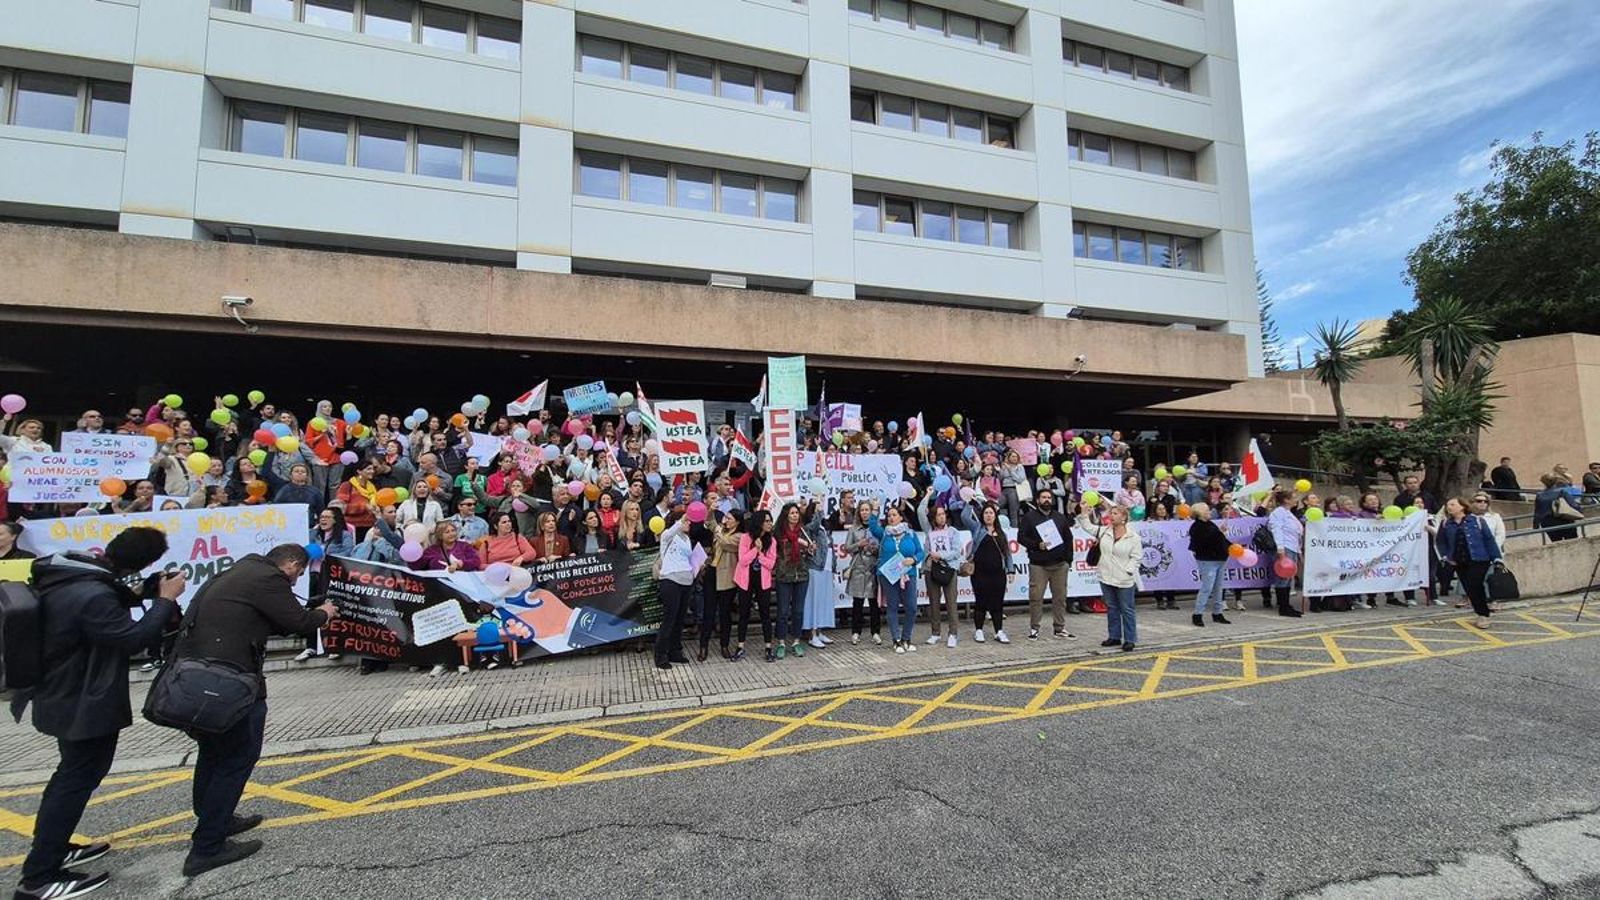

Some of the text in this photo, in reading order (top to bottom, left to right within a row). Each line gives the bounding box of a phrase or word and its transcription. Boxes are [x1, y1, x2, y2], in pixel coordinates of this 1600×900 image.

[665, 425, 702, 437] USTEA
[91, 438, 122, 447] SIN
[41, 456, 67, 465] CON
[770, 408, 794, 497] CCOO
[668, 455, 705, 467] USTEA
[33, 492, 76, 500] JUEGA
[190, 535, 228, 561] AL
[1327, 540, 1368, 549] RECURSOS
[536, 556, 600, 573] PROFESIONALES,
[348, 570, 425, 592] recortas
[537, 563, 613, 583] CON TUS RECORTES
[556, 574, 615, 591] NO PODEMOS
[329, 580, 426, 604] MIS APOYOS EDUCATIVOS
[561, 584, 617, 600] CONCILIAR
[632, 623, 662, 635] MUCHO
